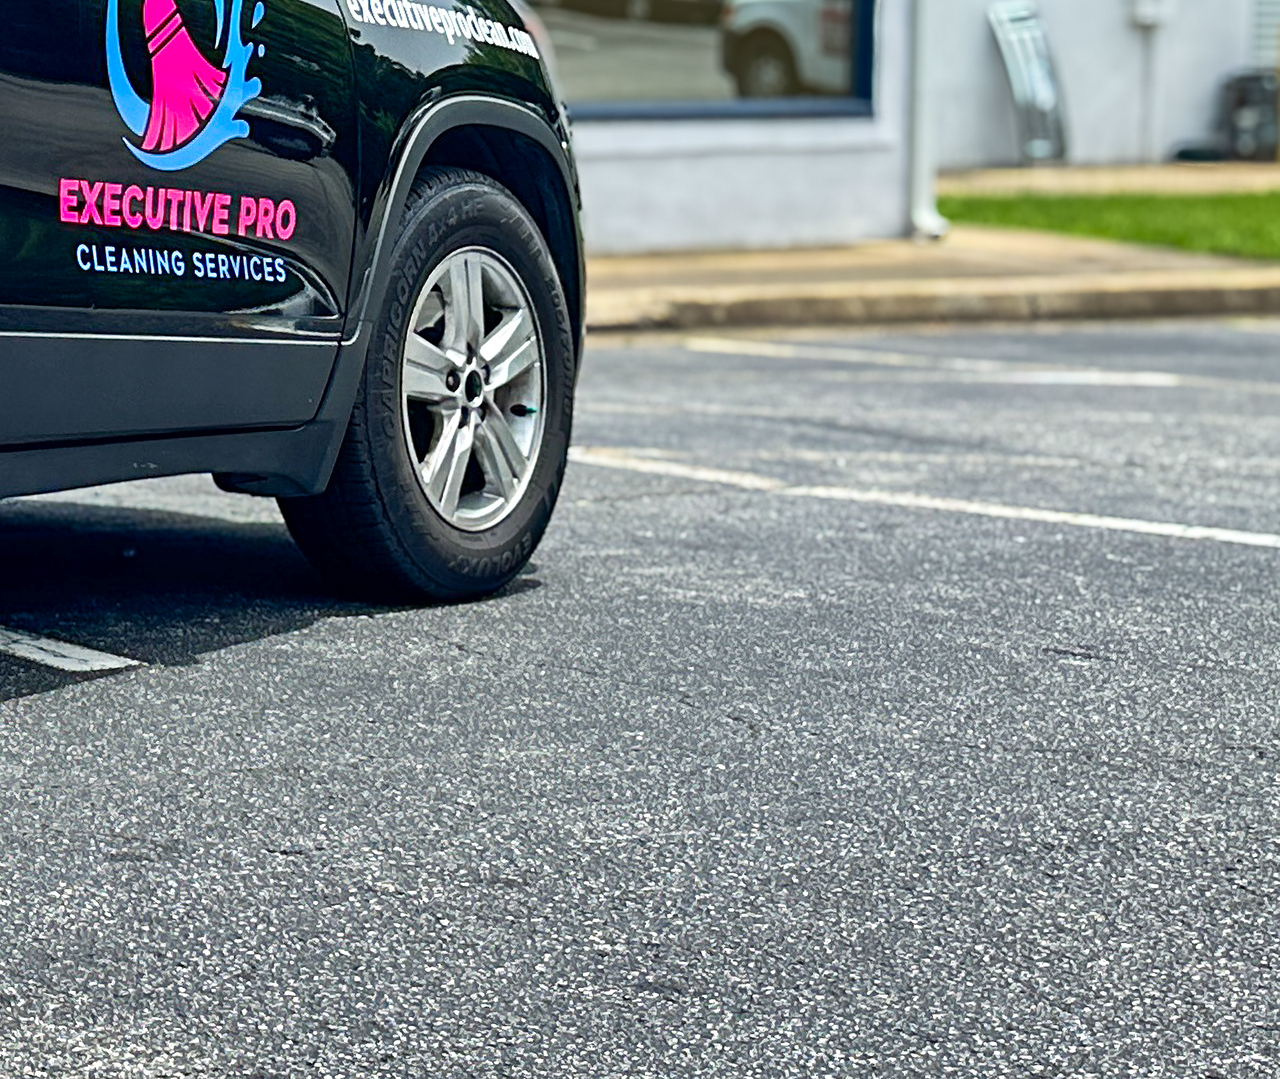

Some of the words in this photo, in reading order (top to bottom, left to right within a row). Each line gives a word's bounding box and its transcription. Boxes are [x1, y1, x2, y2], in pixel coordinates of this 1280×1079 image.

[59, 178, 231, 235] EXECUTIVE
[237, 196, 297, 240] PRO
[76, 243, 185, 276] CLEANING
[193, 252, 286, 283] SERVICES
